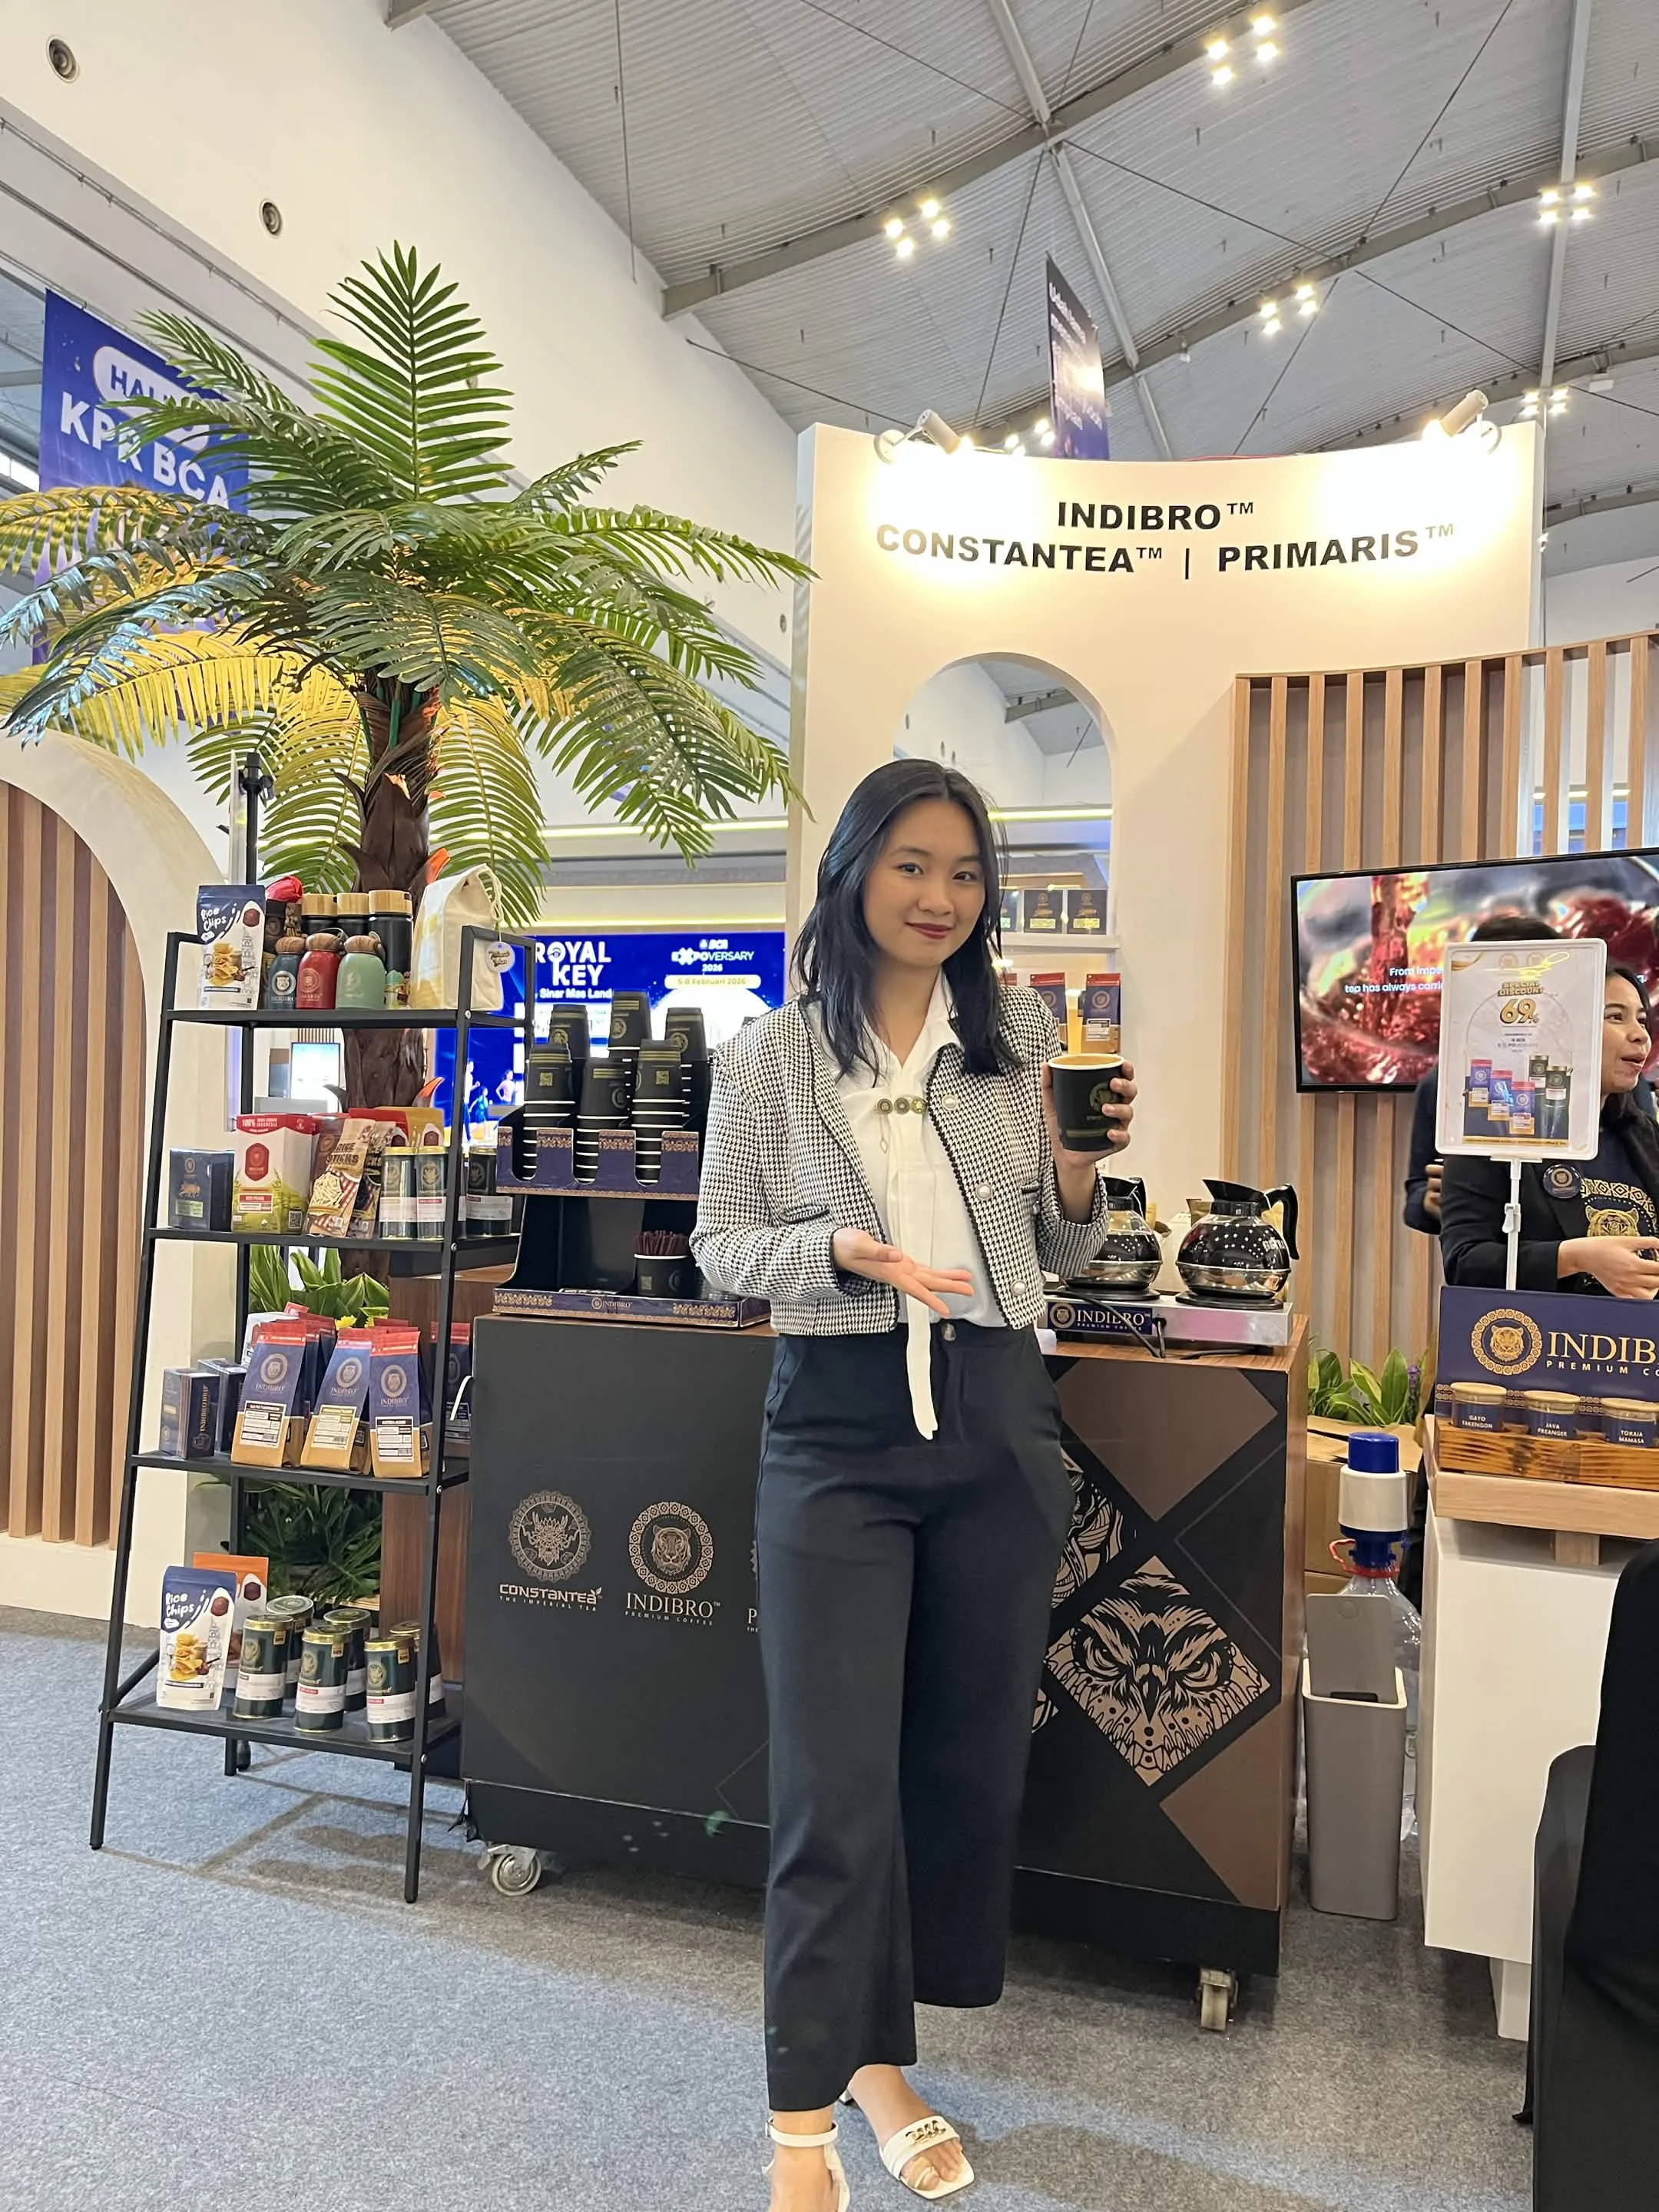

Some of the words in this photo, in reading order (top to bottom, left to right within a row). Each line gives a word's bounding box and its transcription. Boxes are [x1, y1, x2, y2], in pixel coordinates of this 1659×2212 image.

[61, 392, 142, 473] KPR
[154, 440, 229, 510] BCA
[200, 907, 220, 921] Rice
[203, 916, 227, 932] Chips
[535, 941, 612, 963] ROYAL
[701, 963, 724, 972] 2026
[1389, 967, 1415, 976] From
[552, 964, 604, 986] KEY
[539, 988, 565, 998] Sinar
[587, 988, 613, 998] Land
[1344, 984, 1361, 993] tea
[1363, 983, 1381, 993] has
[1382, 982, 1416, 995] always
[1498, 988, 1544, 996] DISCOUNT
[326, 1154, 359, 1166] STICKS
[1547, 1331, 1659, 1364] INDIB
[1546, 1360, 1628, 1374] PREMIUM
[1462, 1420, 1493, 1429] TAKENGON
[1537, 1428, 1568, 1437] PREANGER
[165, 1592, 188, 1605] Rice
[523, 1598, 571, 1609] IMPERIAL
[166, 1602, 195, 1618] Chips
[624, 1610, 670, 1621] PREMIUM
[676, 1616, 713, 1626] COFFEE
